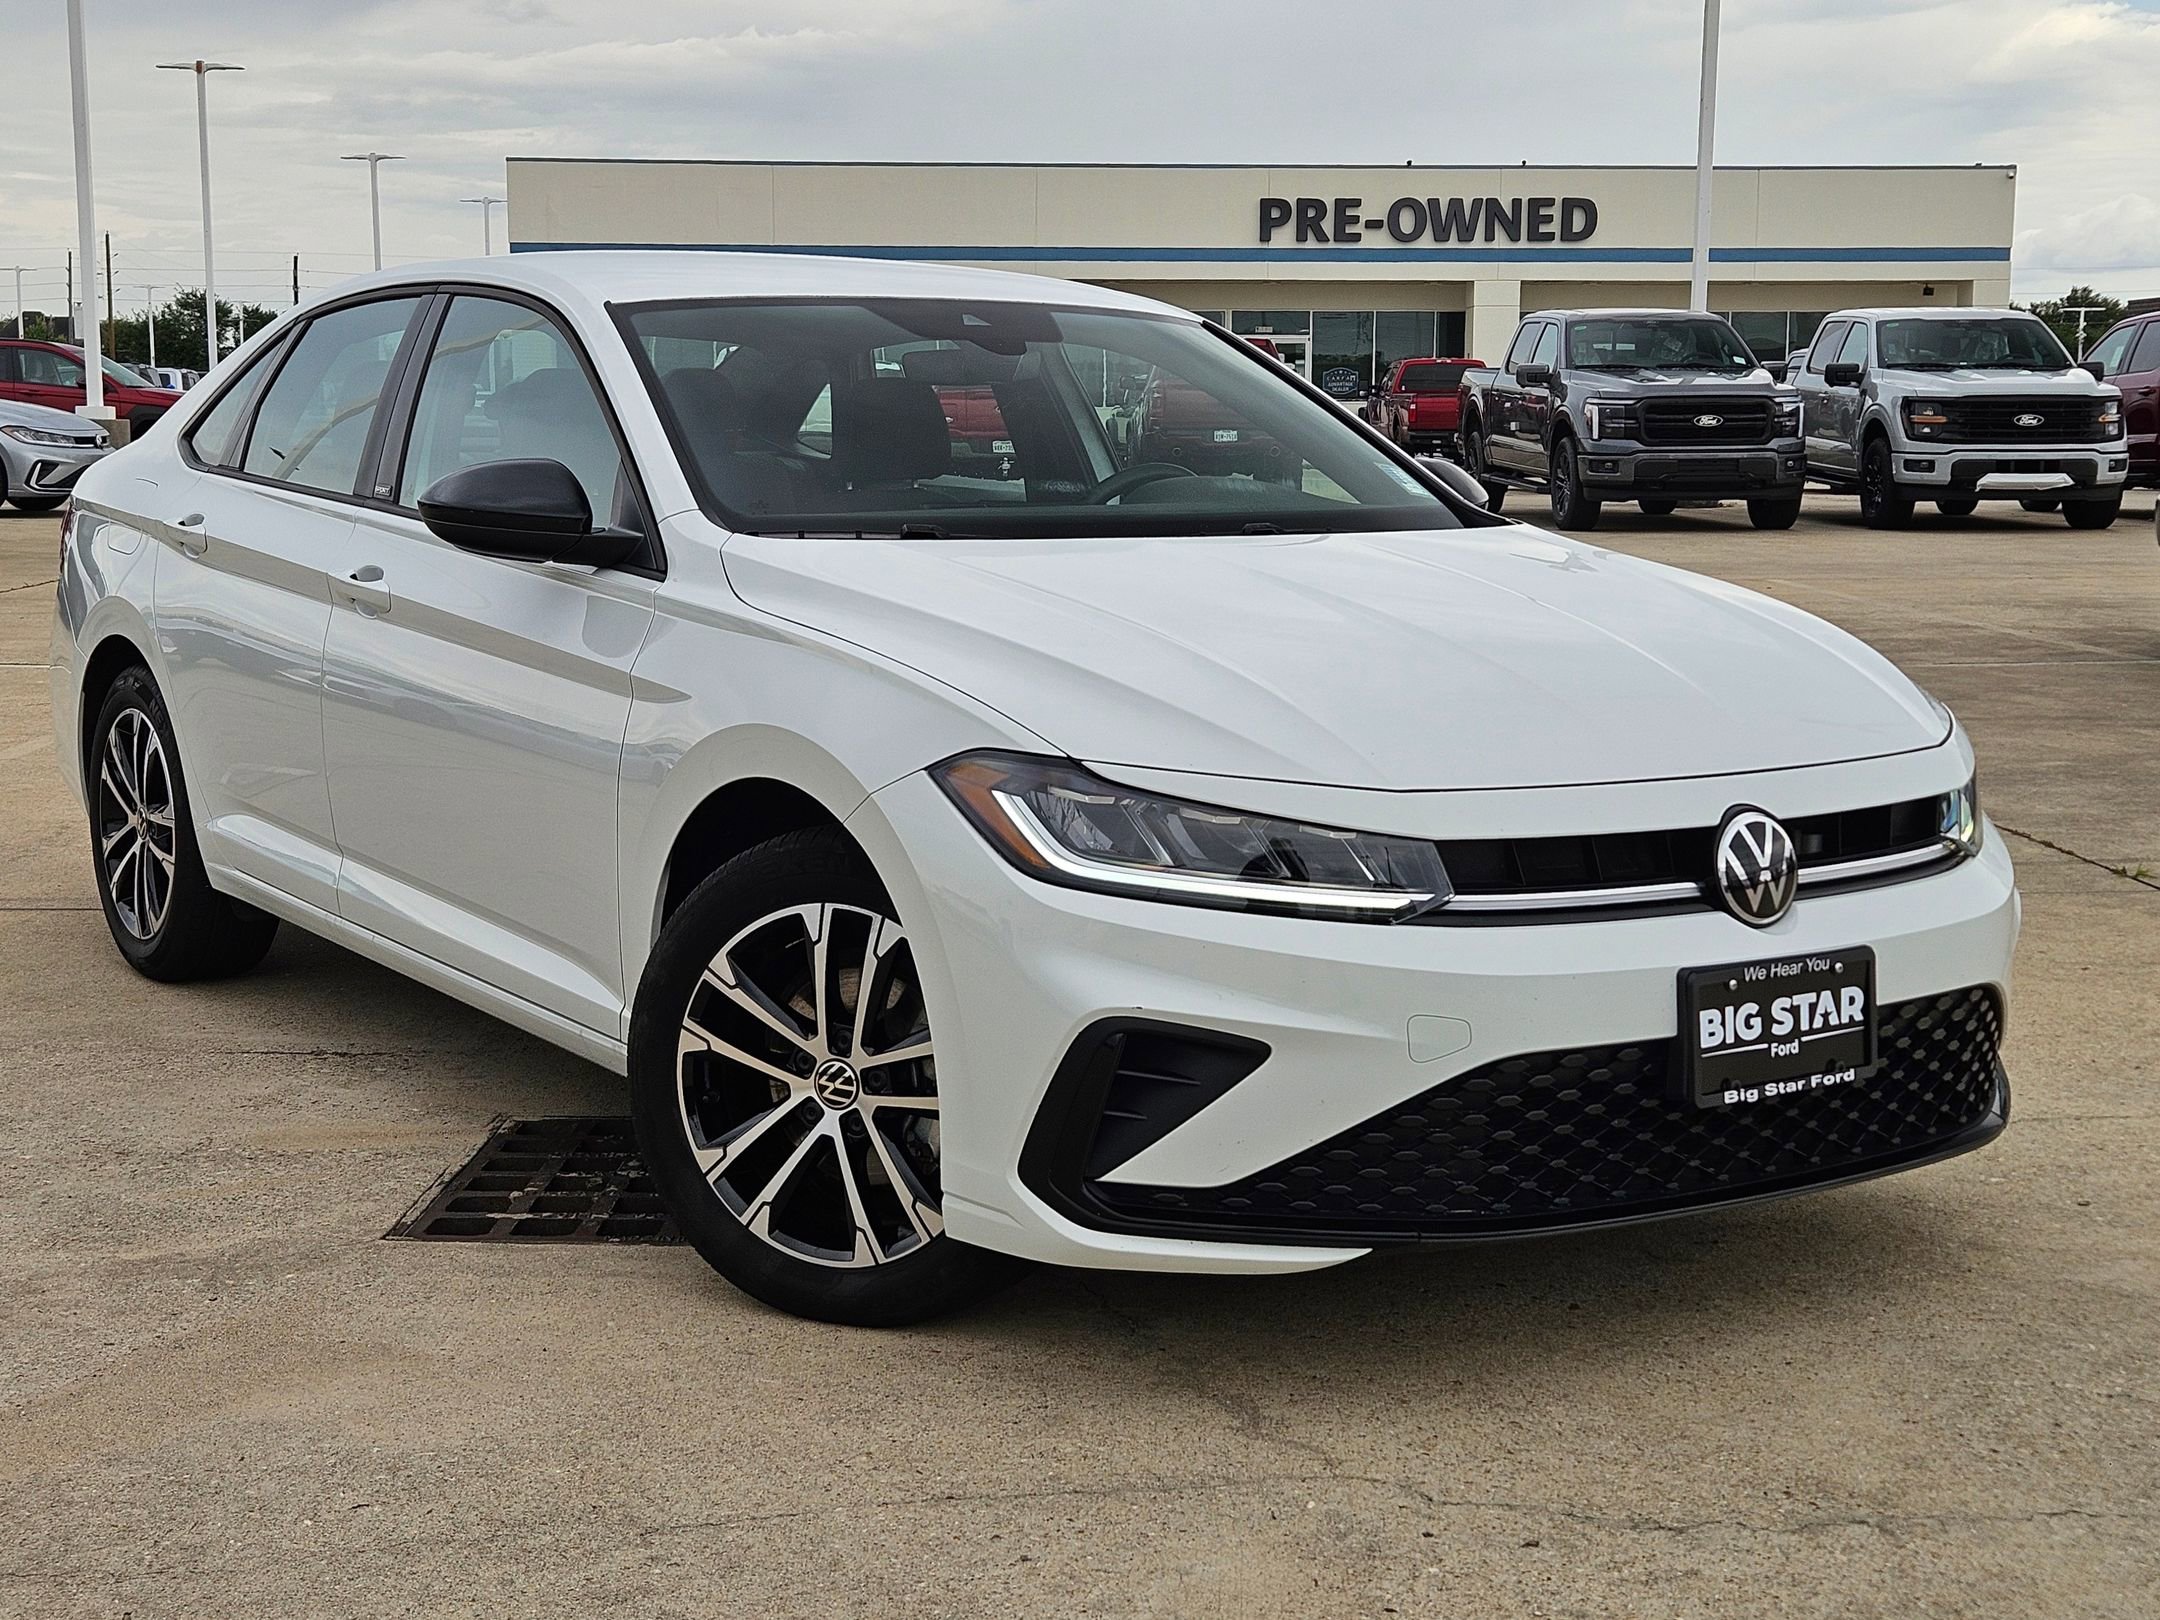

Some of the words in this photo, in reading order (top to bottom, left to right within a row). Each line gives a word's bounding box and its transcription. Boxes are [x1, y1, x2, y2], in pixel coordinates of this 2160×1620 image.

[1259, 197, 1599, 243] PRE-OWNED
[1744, 967, 1767, 982] We
[1770, 962, 1803, 978] Hear
[1805, 957, 1830, 973] You
[1699, 1002, 1763, 1049] BIG
[1770, 985, 1865, 1036] STAR
[1770, 1039, 1800, 1058] Ford
[1723, 1087, 1759, 1104] Big
[1764, 1079, 1806, 1097] Star
[1810, 1068, 1855, 1088] Ford
